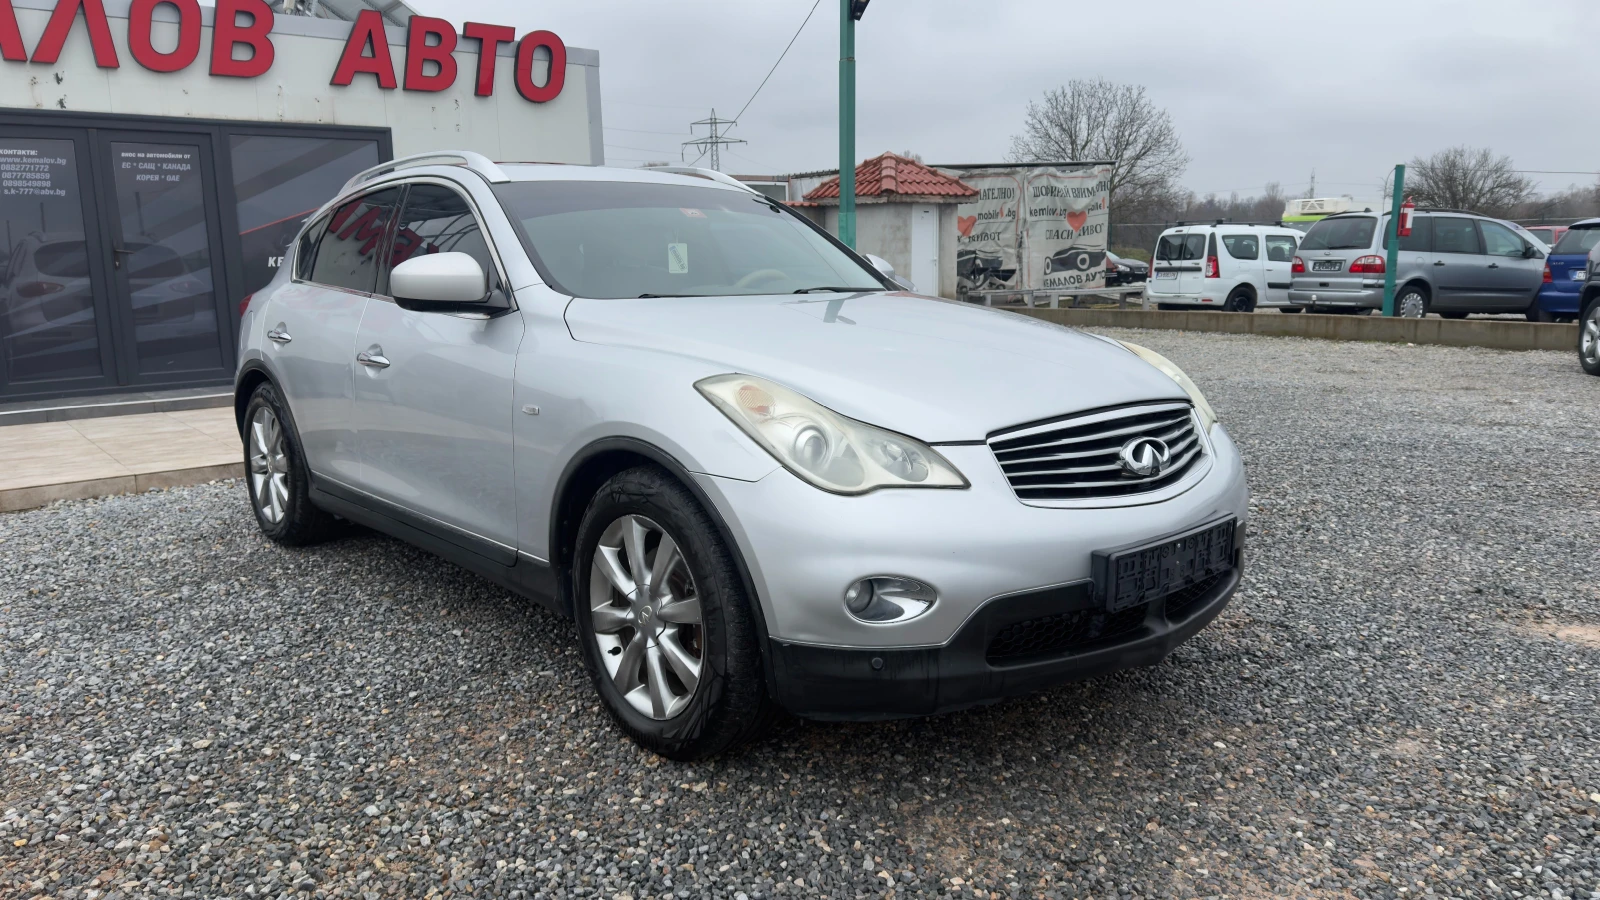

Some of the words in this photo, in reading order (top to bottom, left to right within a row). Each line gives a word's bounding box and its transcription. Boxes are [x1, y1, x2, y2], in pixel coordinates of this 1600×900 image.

[329, 8, 567, 103] АВТО
[0, 157, 67, 166] www.kemalov.bg
[121, 161, 132, 169] ЕС
[138, 162, 156, 171] САЩ
[162, 163, 191, 171] КАНАДА
[1, 172, 51, 180] 0877785859
[2, 180, 52, 188] 0898549898
[3, 188, 66, 197] s.k-777@abv.bg
